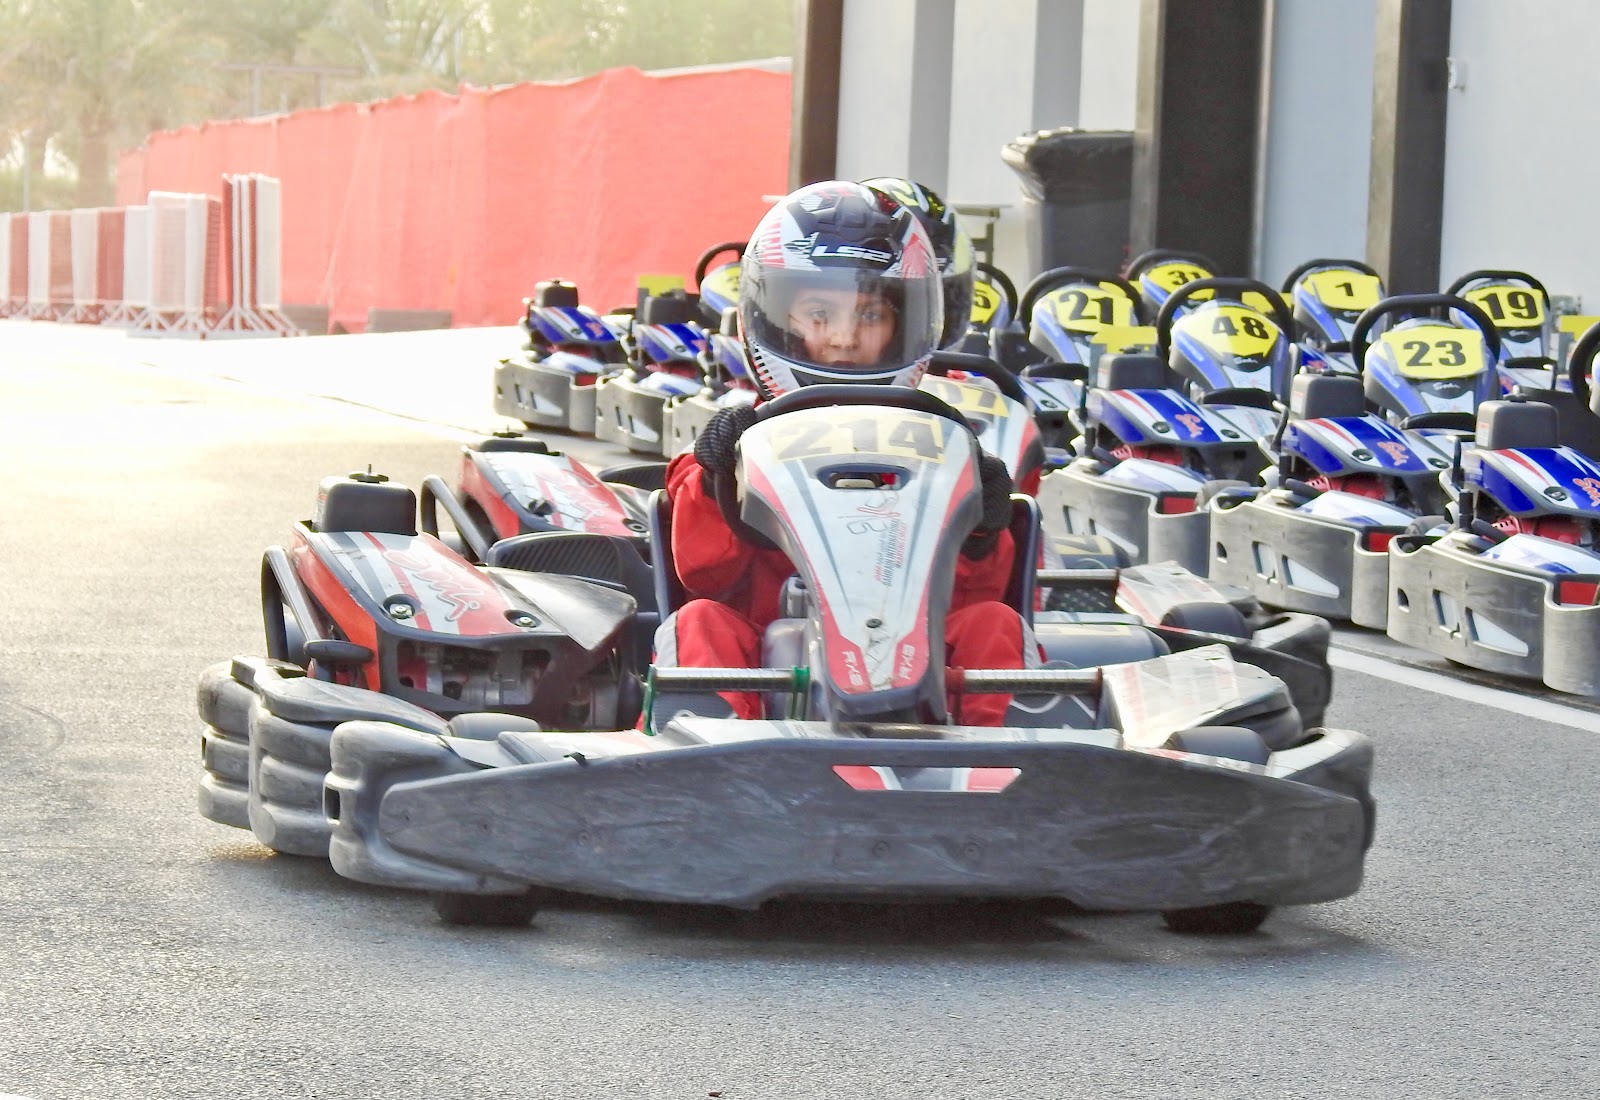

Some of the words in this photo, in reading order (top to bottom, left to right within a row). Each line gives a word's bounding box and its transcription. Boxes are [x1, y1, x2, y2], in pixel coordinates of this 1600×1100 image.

[811, 245, 892, 263] LS2
[1335, 282, 1354, 297] 1
[1059, 291, 1114, 325] 21
[1479, 291, 1539, 320] 19
[1211, 315, 1269, 340] 48
[1403, 341, 1466, 367] 23
[777, 418, 943, 459] 214
